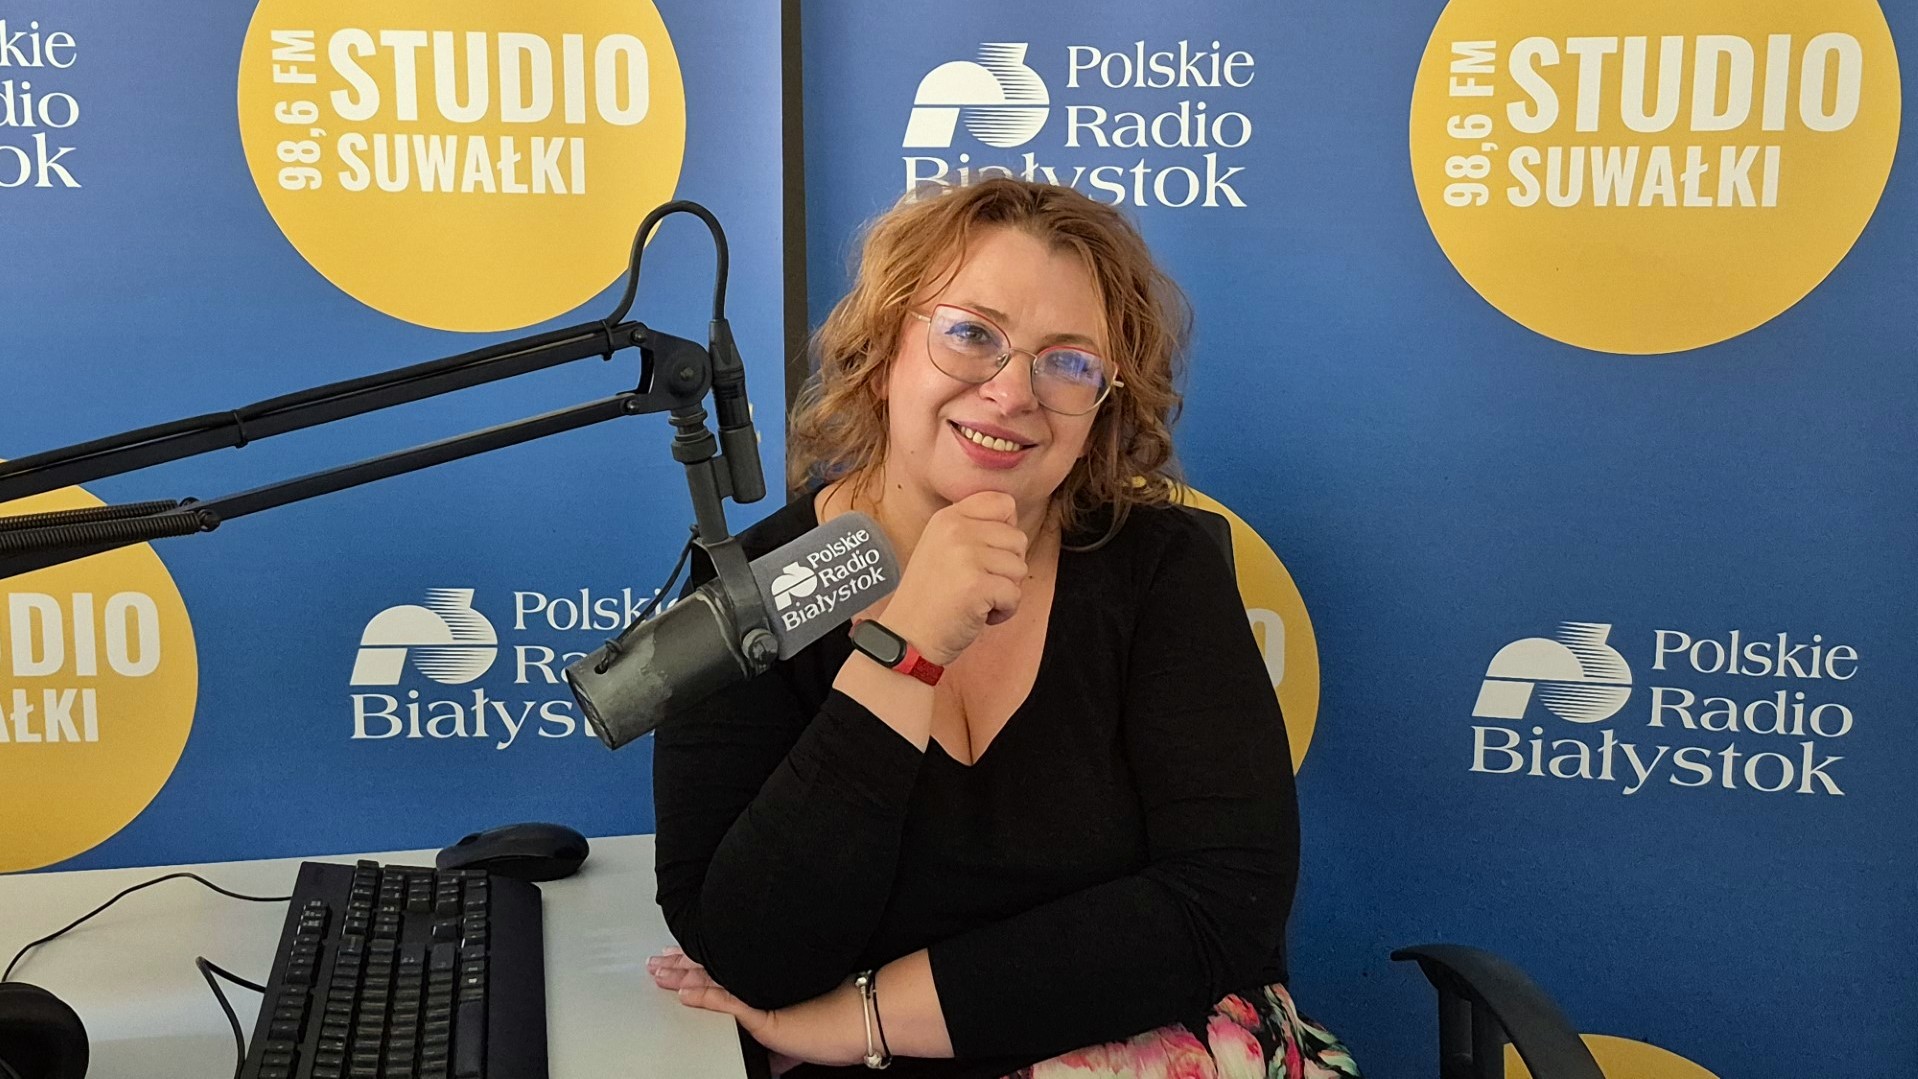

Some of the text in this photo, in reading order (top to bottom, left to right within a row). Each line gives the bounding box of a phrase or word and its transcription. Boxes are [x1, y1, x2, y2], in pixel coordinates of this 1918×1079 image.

[327, 27, 651, 127] STUDIO
[1066, 40, 1255, 89] Polskie
[1506, 32, 1863, 133] STUDIO
[270, 29, 327, 191] 98,6 FM
[1064, 100, 1252, 148] Radio
[1443, 40, 1499, 208] 98,6 FM
[336, 132, 586, 195] SUWAŁKI
[1506, 145, 1782, 208] SUWAŁKI
[806, 529, 870, 569] Polskie
[818, 549, 880, 588] Radio
[513, 587, 680, 631] Polsk
[781, 566, 886, 632] Białystok
[1652, 629, 1859, 681] Polskie
[1646, 686, 1854, 738] Radio
[1468, 725, 1845, 796] Białystok
